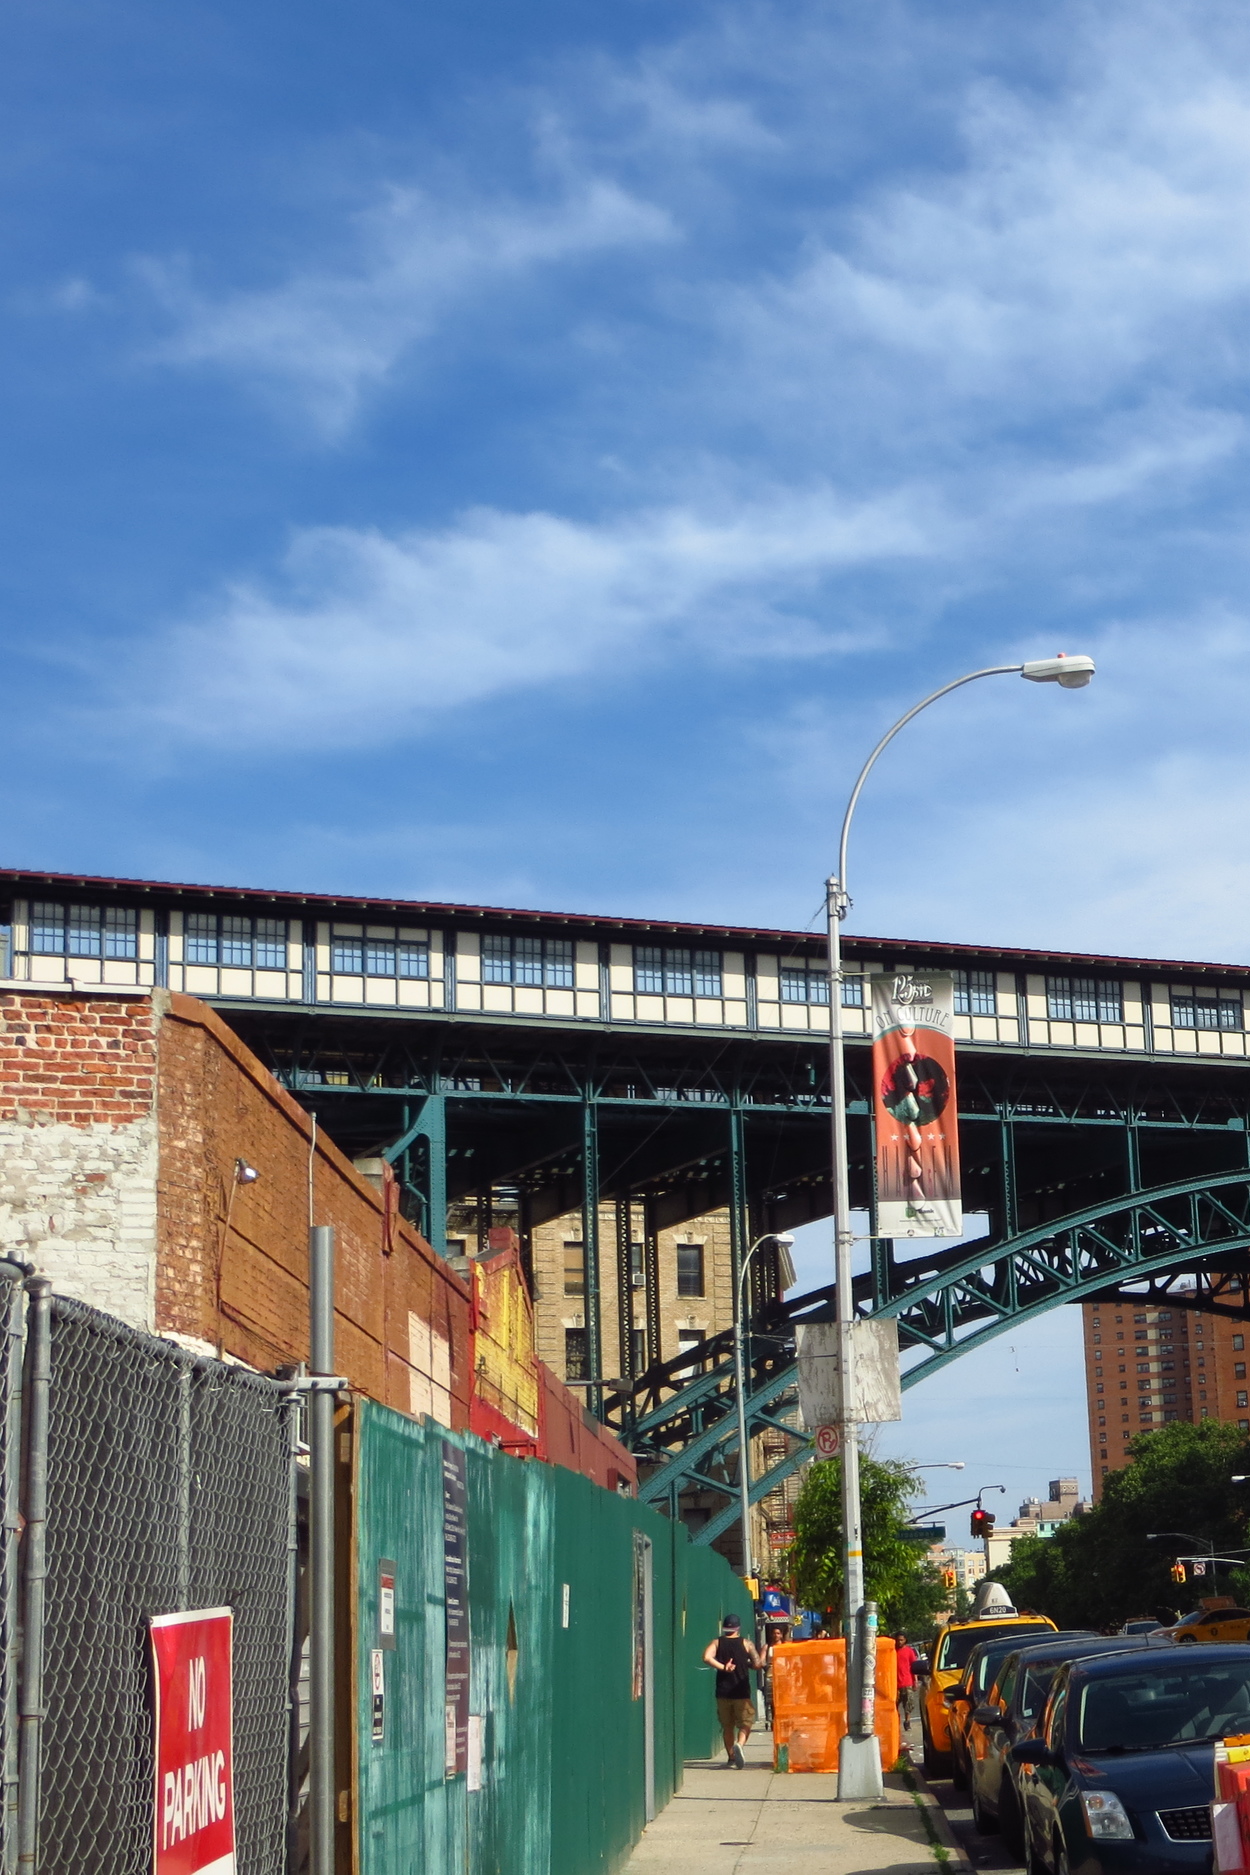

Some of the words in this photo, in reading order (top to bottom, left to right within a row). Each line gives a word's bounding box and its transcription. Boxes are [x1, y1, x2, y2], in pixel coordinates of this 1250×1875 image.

[875, 1010, 894, 1029] ON
[897, 1006, 950, 1027] CULTURE
[989, 1606, 1007, 1614] 6N20
[188, 1655, 206, 1732] NO
[163, 1749, 226, 1851] PARKING
